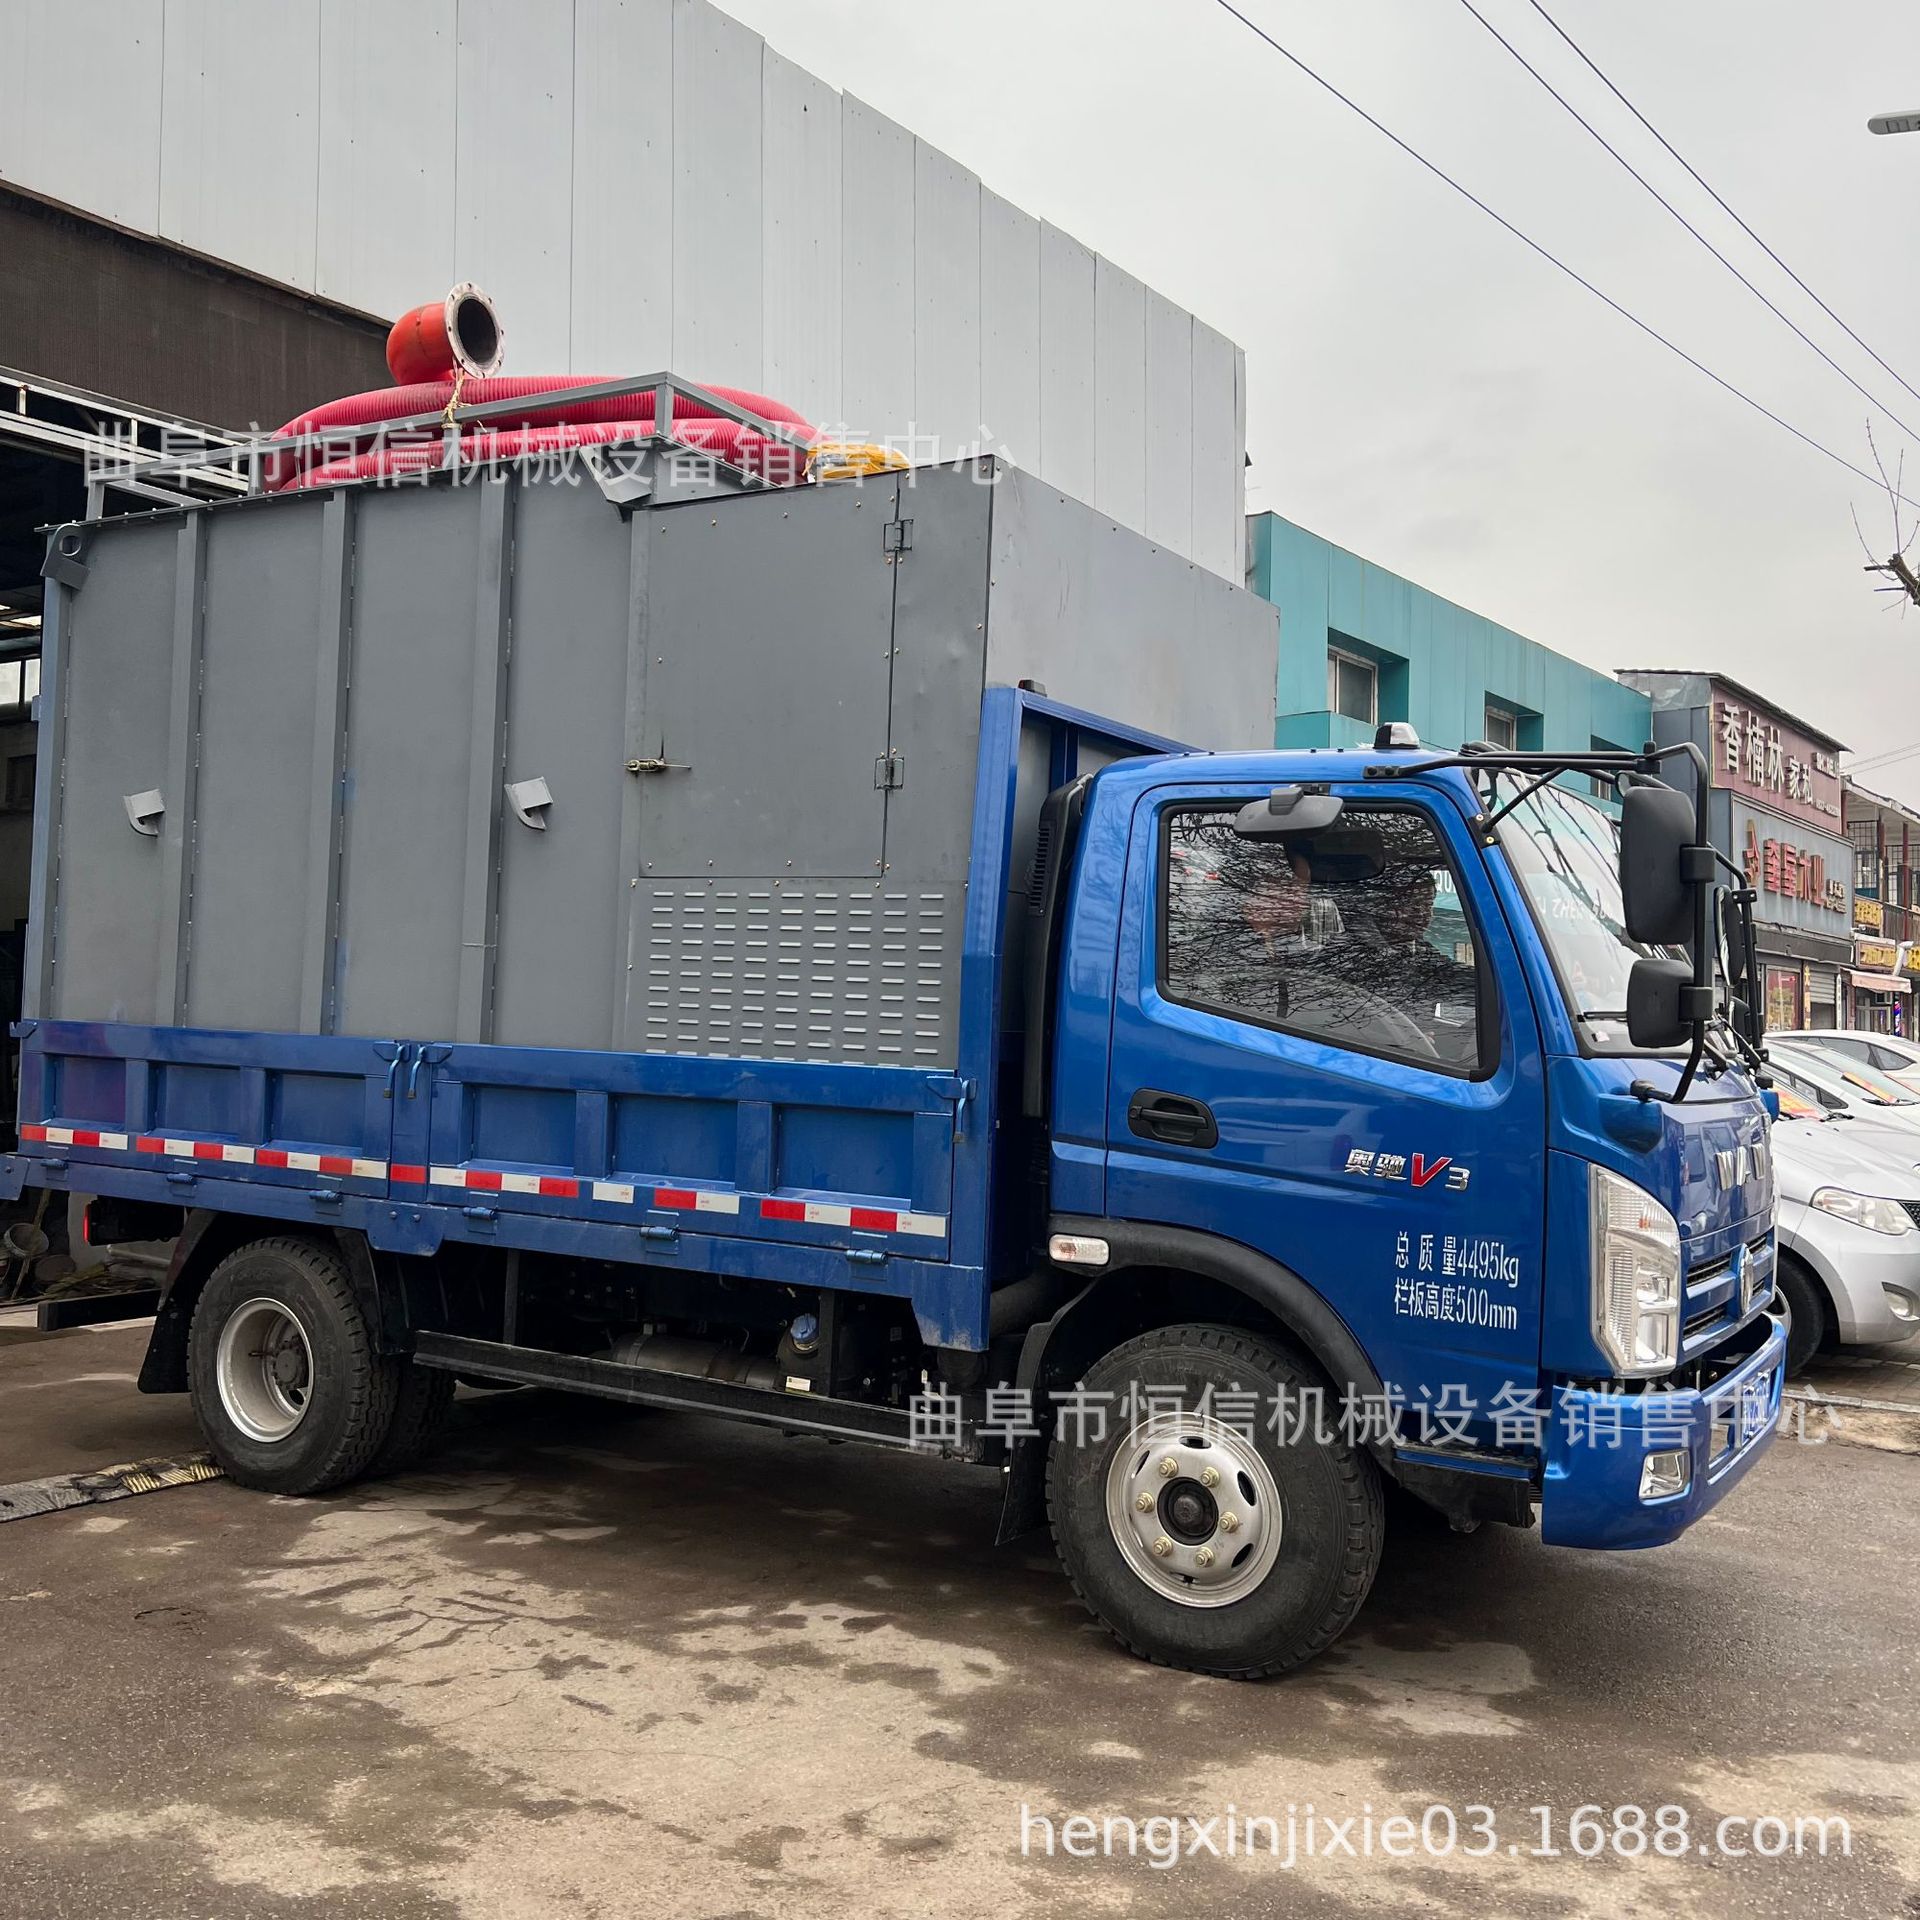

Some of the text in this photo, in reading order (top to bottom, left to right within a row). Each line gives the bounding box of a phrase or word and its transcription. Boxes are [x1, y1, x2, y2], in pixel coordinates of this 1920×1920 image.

[1344, 1149, 1470, 1191] 奥驰V3
[1394, 1277, 1517, 1330] 栏板高度500mm
